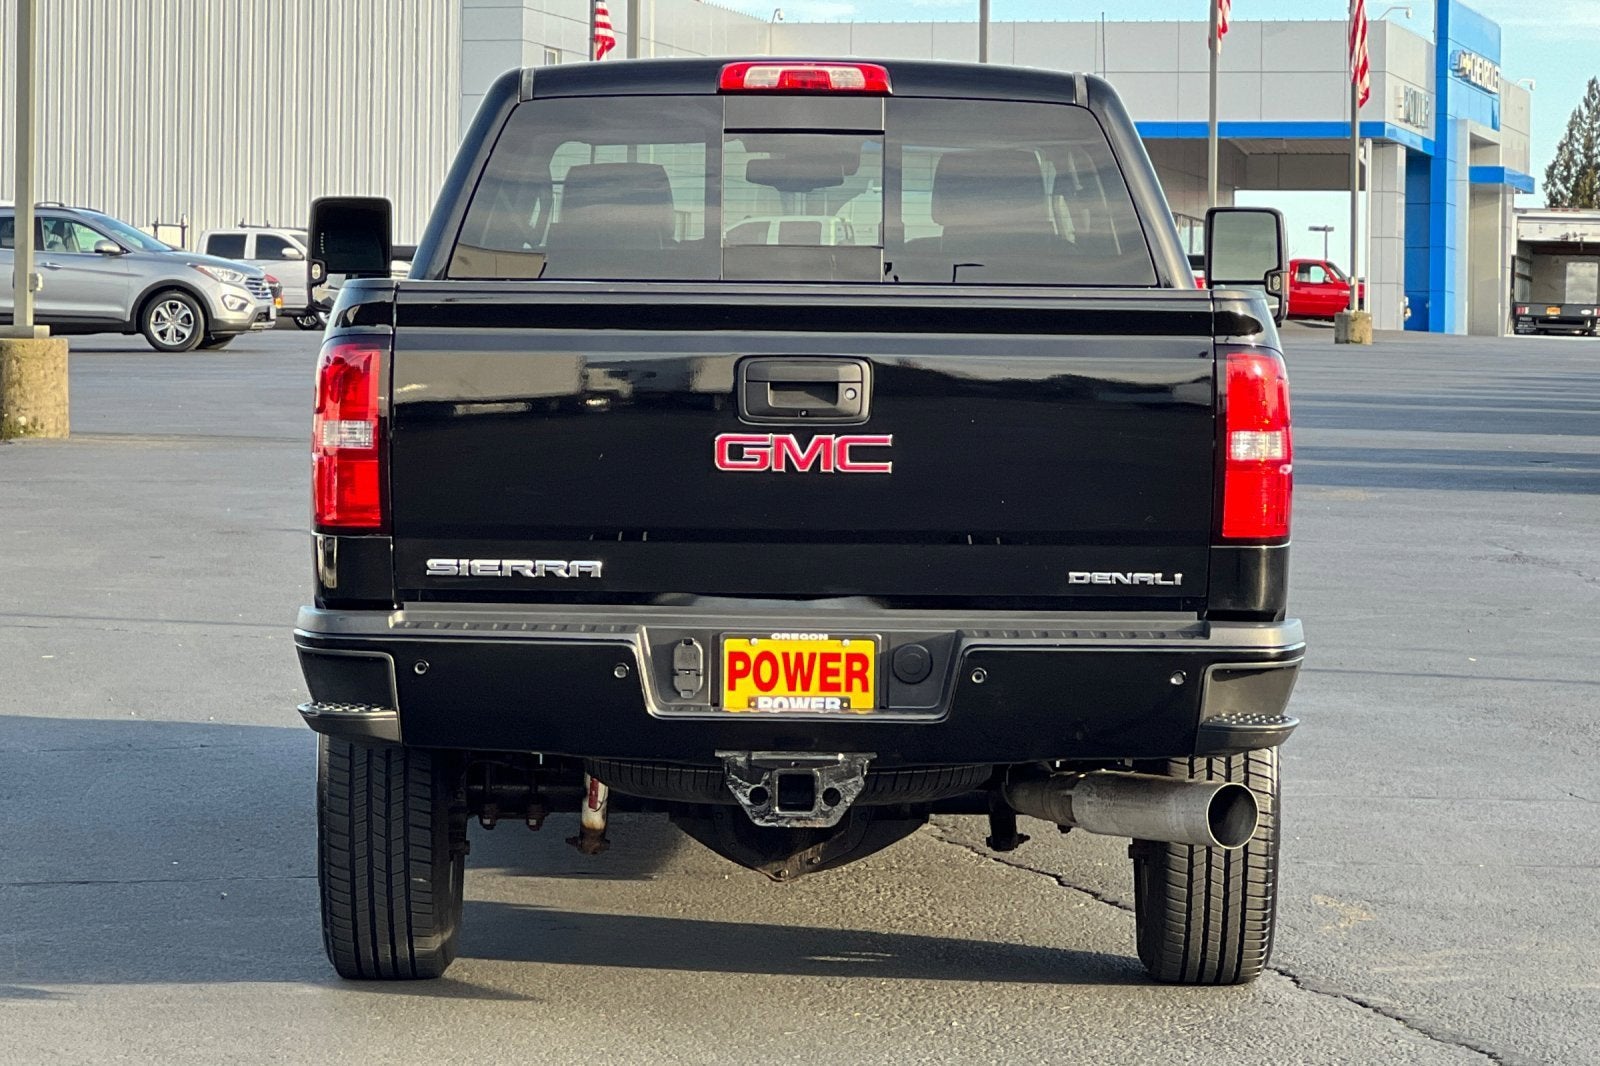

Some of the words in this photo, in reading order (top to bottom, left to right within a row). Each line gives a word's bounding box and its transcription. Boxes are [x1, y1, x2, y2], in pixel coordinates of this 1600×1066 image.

[714, 433, 893, 474] GMC
[426, 558, 603, 578] SIERRA
[1068, 571, 1183, 585] DENALI
[728, 650, 870, 692] POWER
[757, 697, 842, 710] POWER
